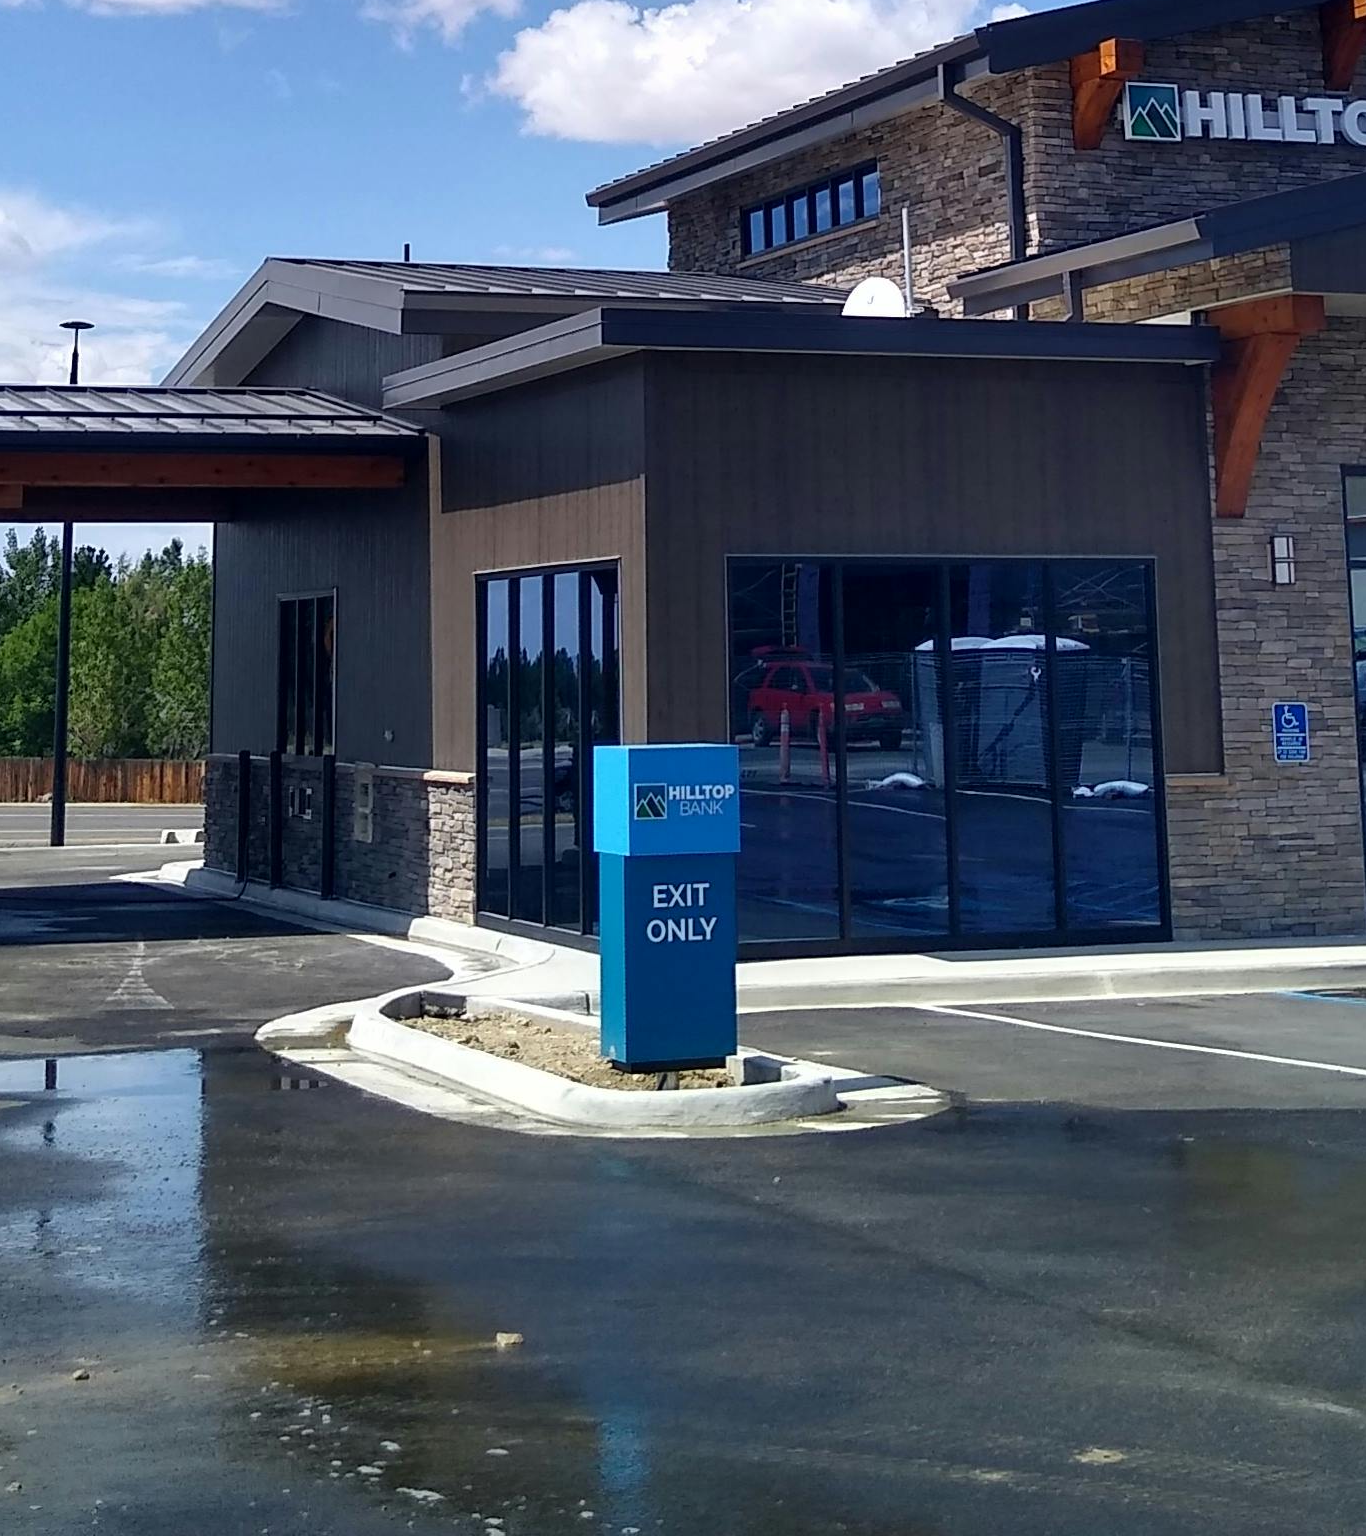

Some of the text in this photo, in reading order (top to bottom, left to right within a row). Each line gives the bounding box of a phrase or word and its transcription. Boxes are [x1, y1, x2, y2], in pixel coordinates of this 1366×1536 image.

[668, 784, 735, 800] HILLTOP
[679, 800, 724, 816] BANK
[653, 883, 710, 908] EXIT
[646, 917, 717, 943] ONLY
